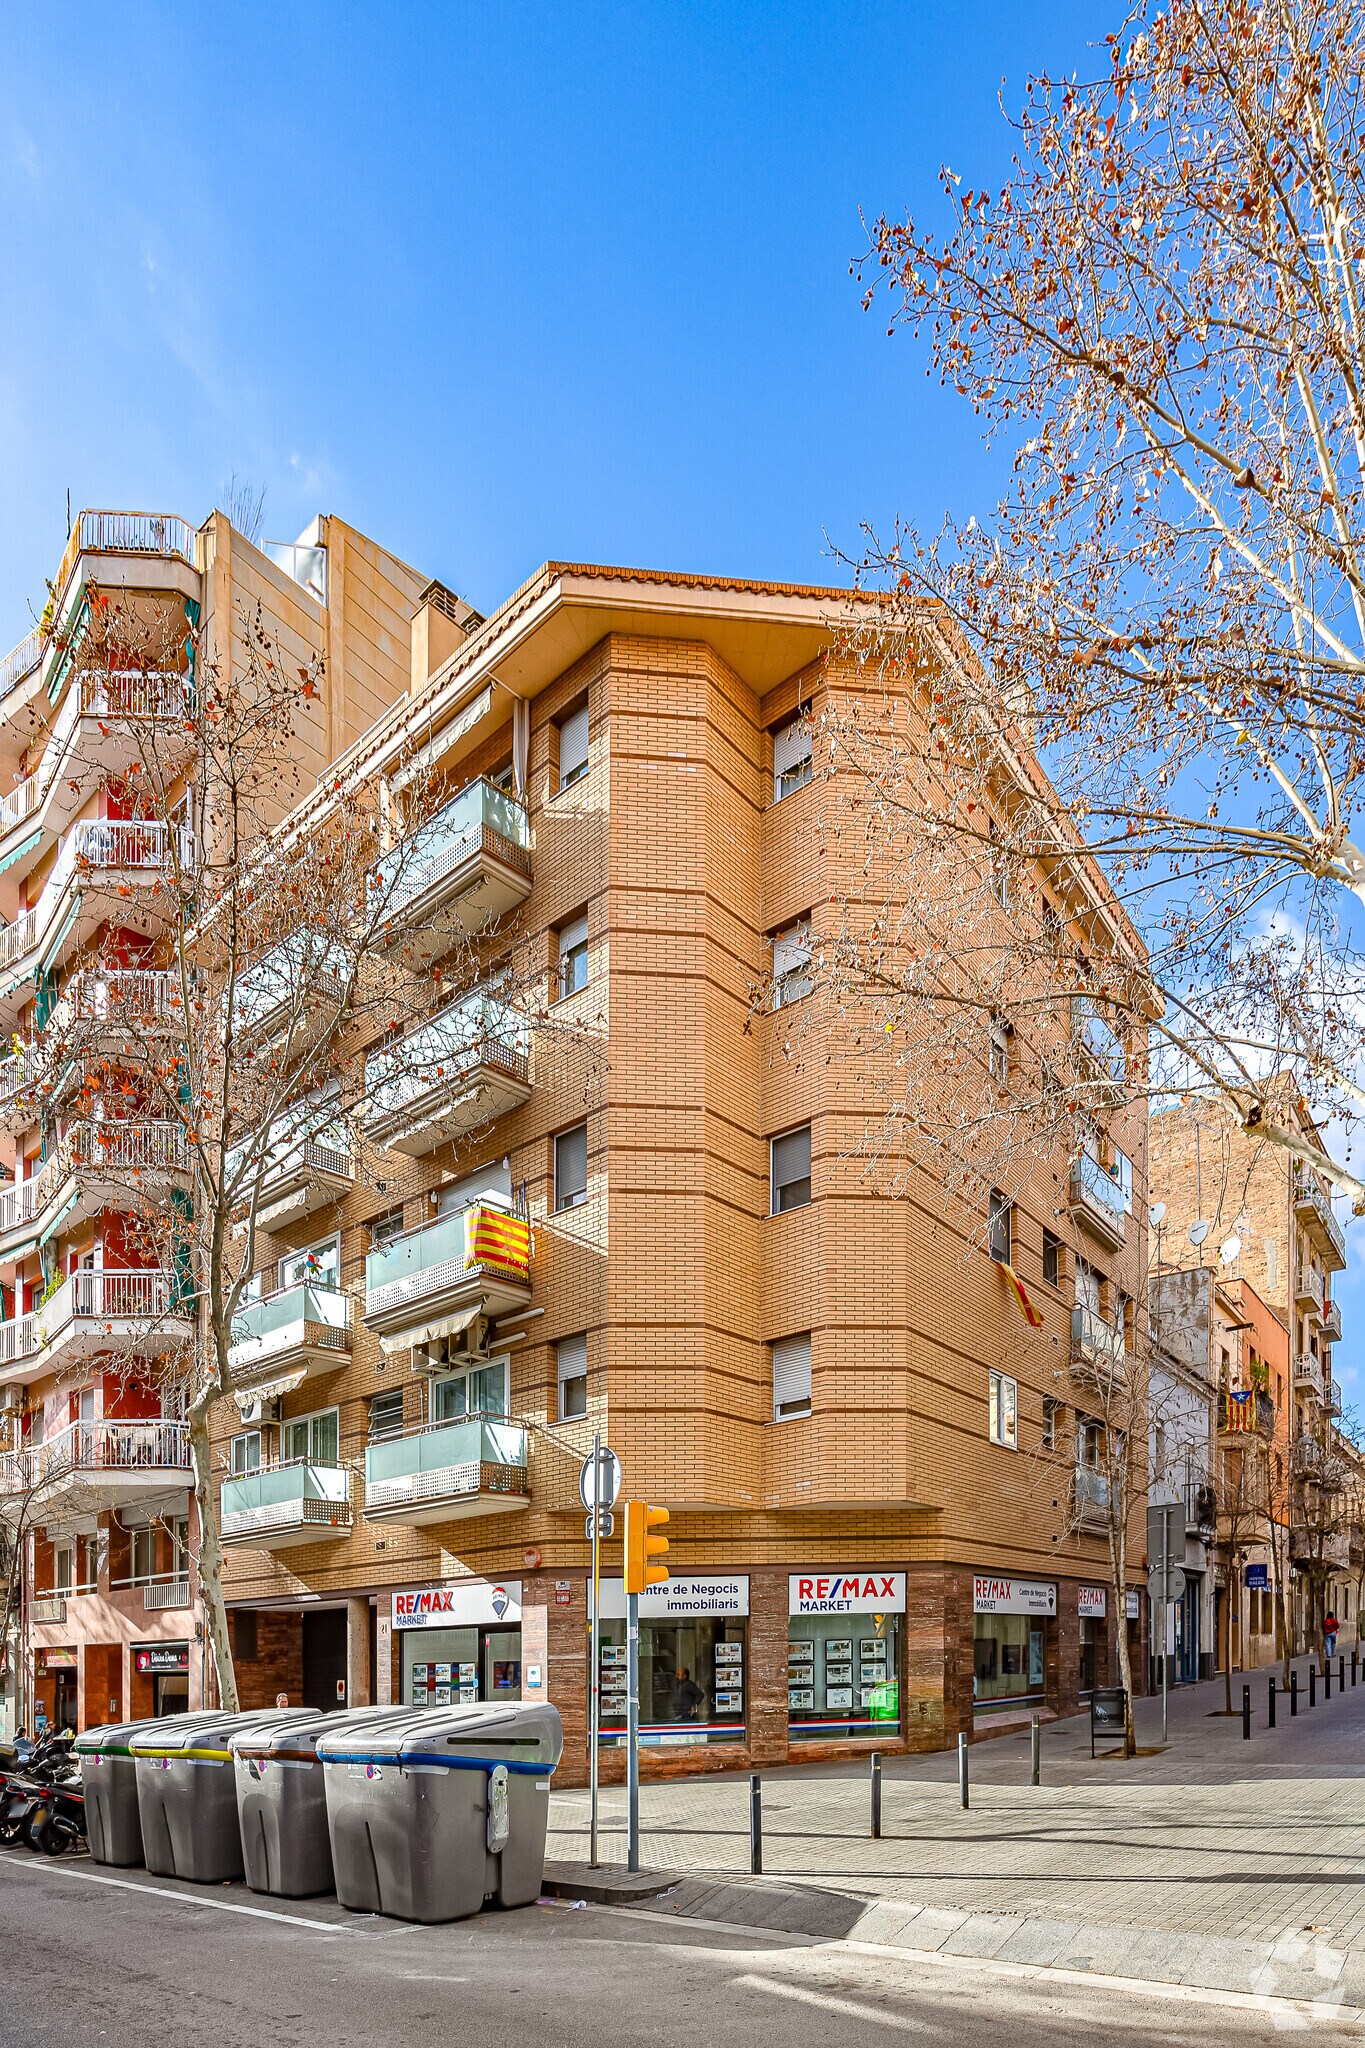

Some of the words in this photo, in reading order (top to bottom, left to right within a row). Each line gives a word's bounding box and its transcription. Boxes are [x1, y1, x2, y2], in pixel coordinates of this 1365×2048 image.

[639, 1584, 669, 1596] entre
[673, 1584, 688, 1595] de
[691, 1583, 739, 1597] Negocis
[799, 1577, 895, 1599] RE/MAX
[976, 1579, 1011, 1599] RE/MAX
[396, 1592, 453, 1614] RE/MAX
[667, 1598, 739, 1610] immobiliaris
[1079, 1589, 1103, 1605] RE/MAX
[800, 1600, 852, 1612] MARKET
[976, 1600, 996, 1610] MARKET
[396, 1614, 428, 1626] MARKET
